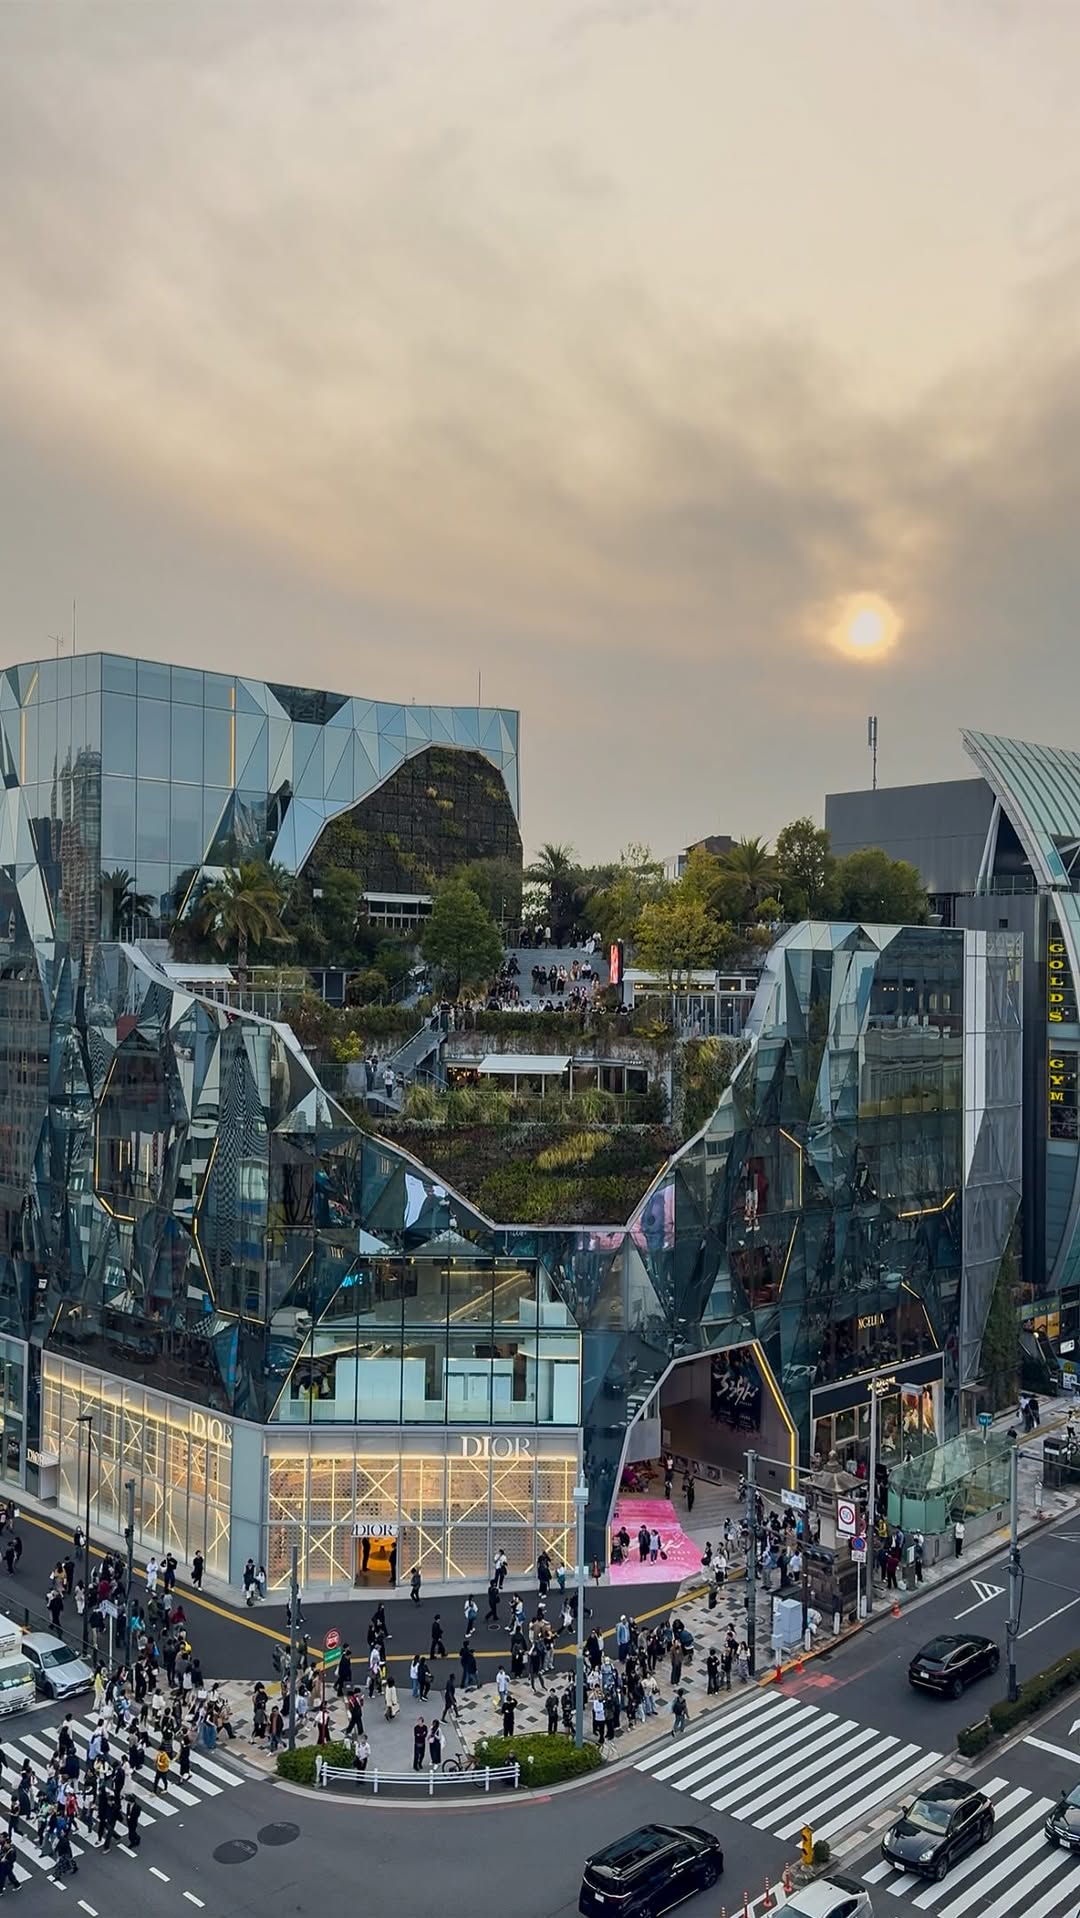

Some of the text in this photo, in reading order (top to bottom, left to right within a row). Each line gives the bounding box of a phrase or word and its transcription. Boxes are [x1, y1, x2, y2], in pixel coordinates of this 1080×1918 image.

[1049, 1059, 1065, 1101] GYM
[193, 1411, 233, 1448] DIOR
[460, 1436, 534, 1458] DIOR
[355, 1524, 393, 1536] DIOR
